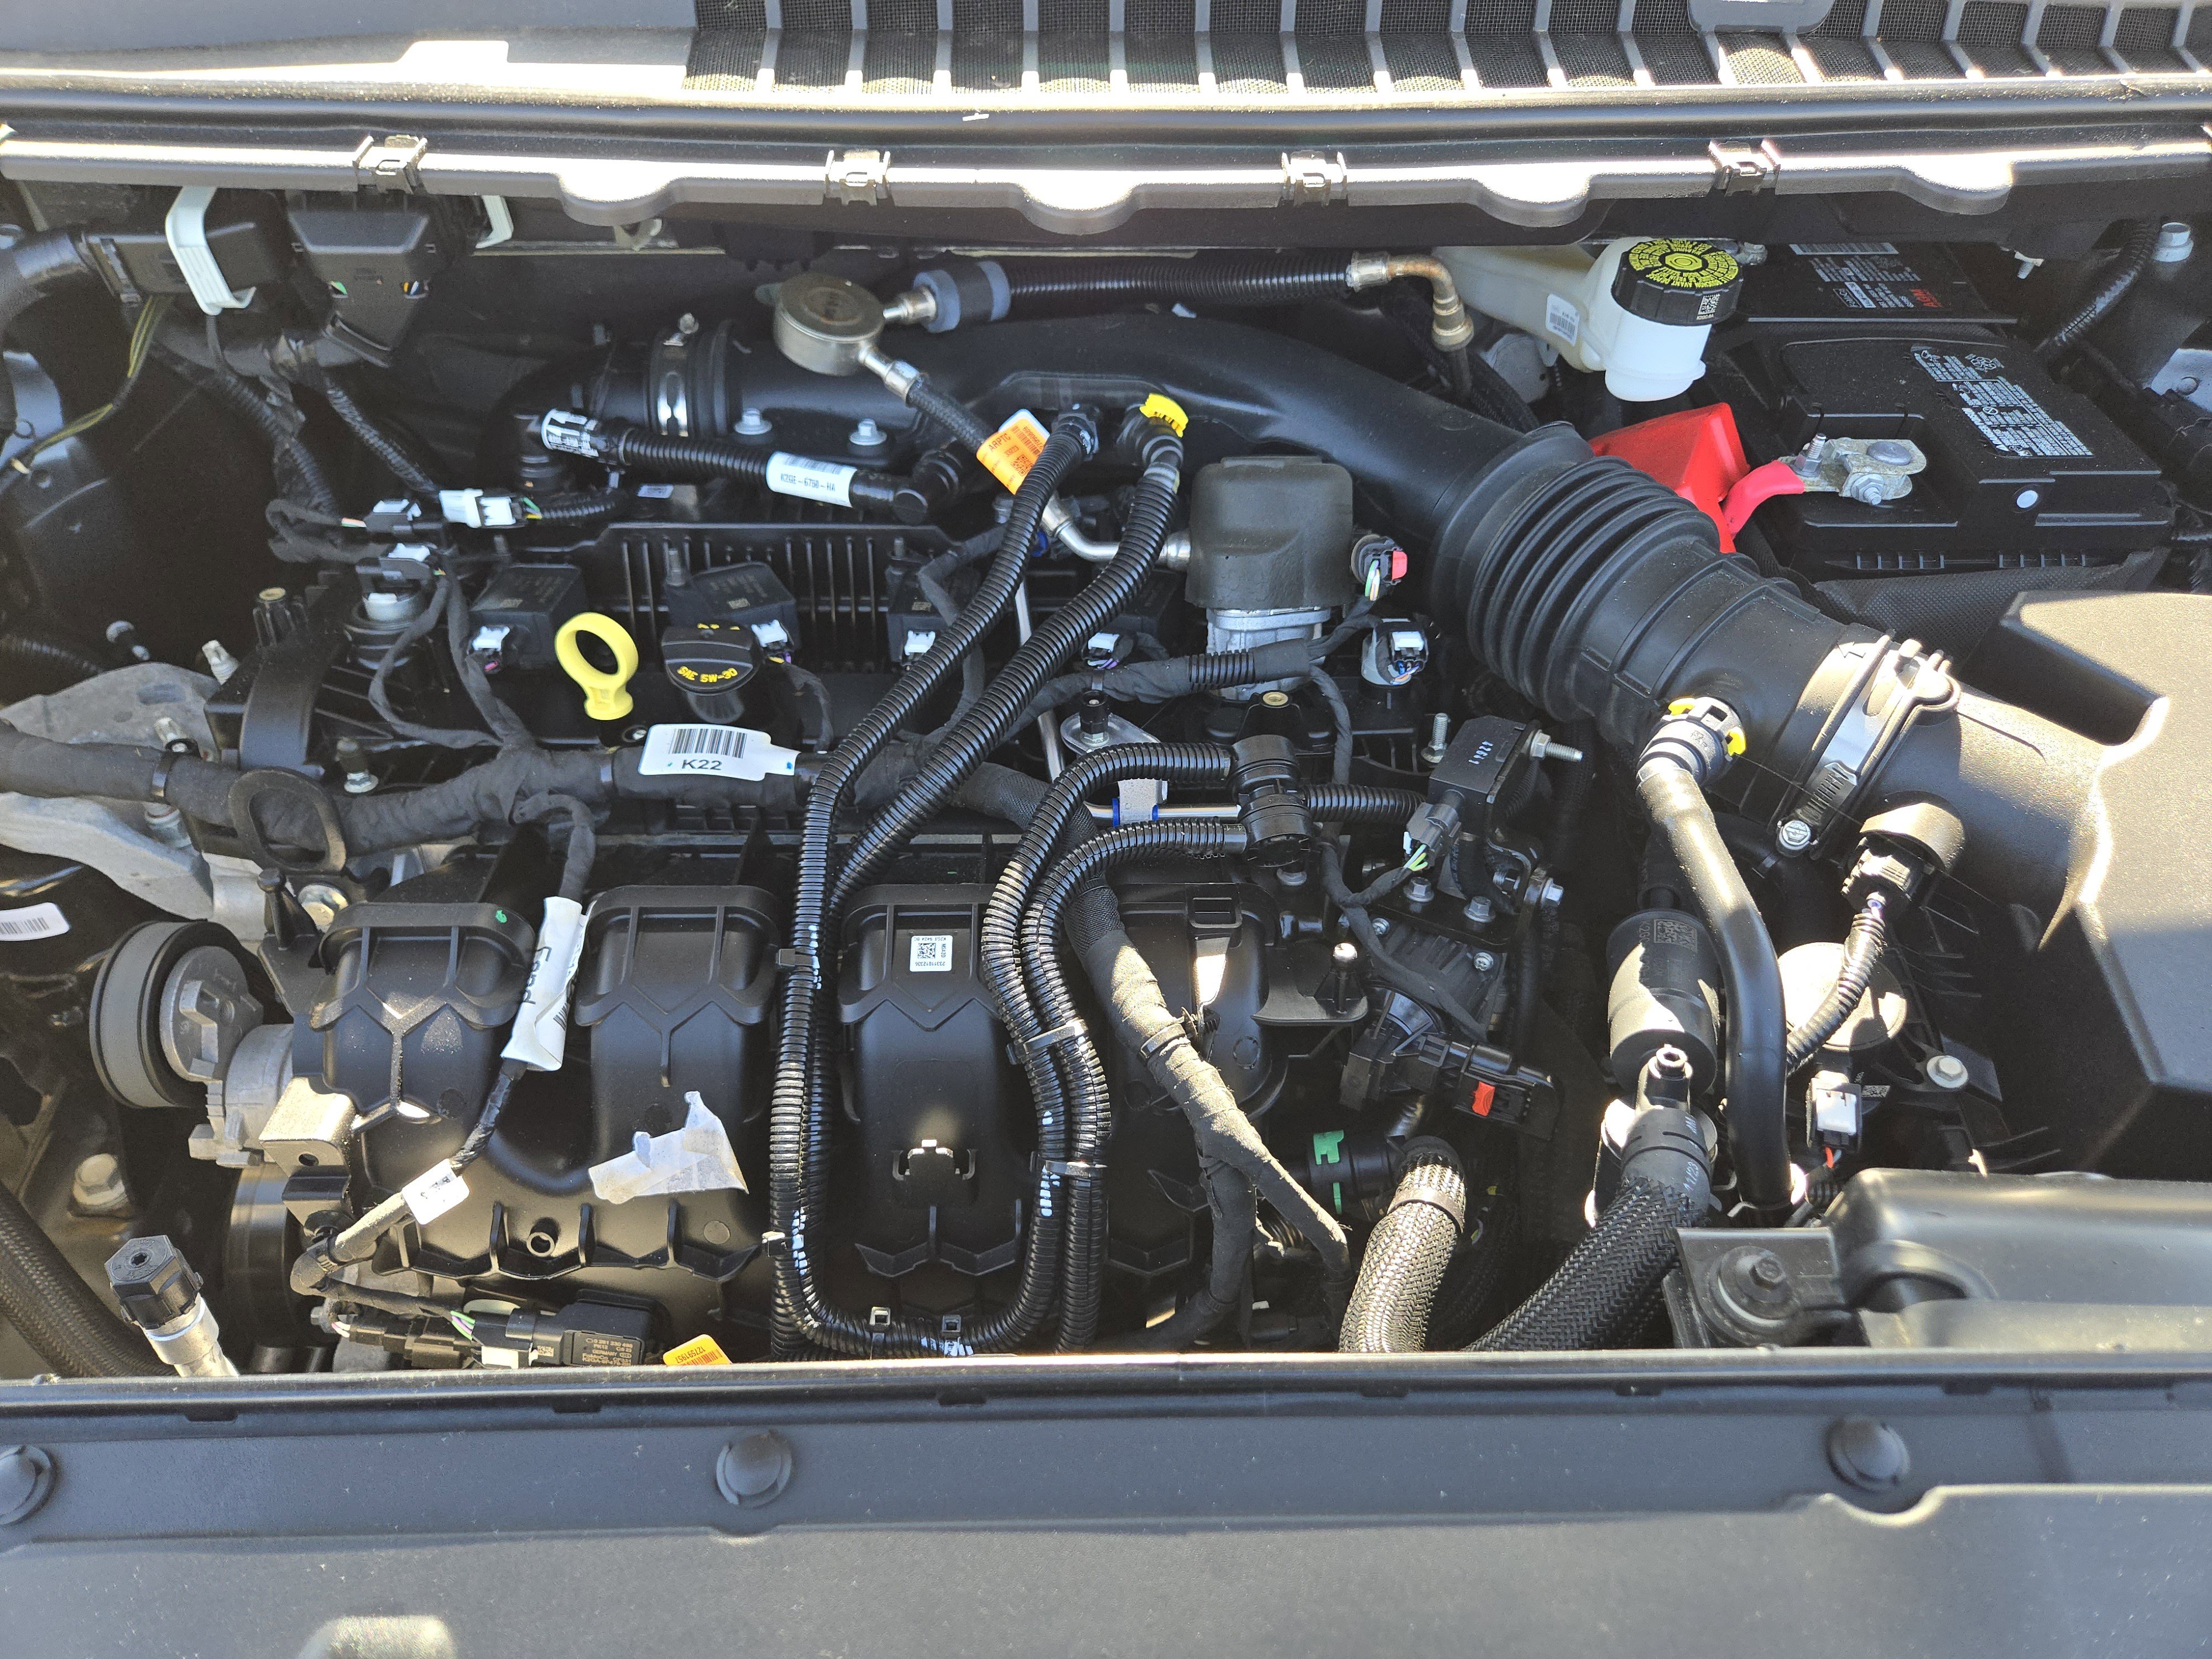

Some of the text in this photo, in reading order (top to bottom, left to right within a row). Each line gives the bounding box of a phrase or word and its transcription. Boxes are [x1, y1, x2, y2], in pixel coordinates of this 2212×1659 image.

[677, 666, 738, 682] SAE 5W-30
[682, 759, 722, 770] K22
[675, 1346, 706, 1364] 127591957
